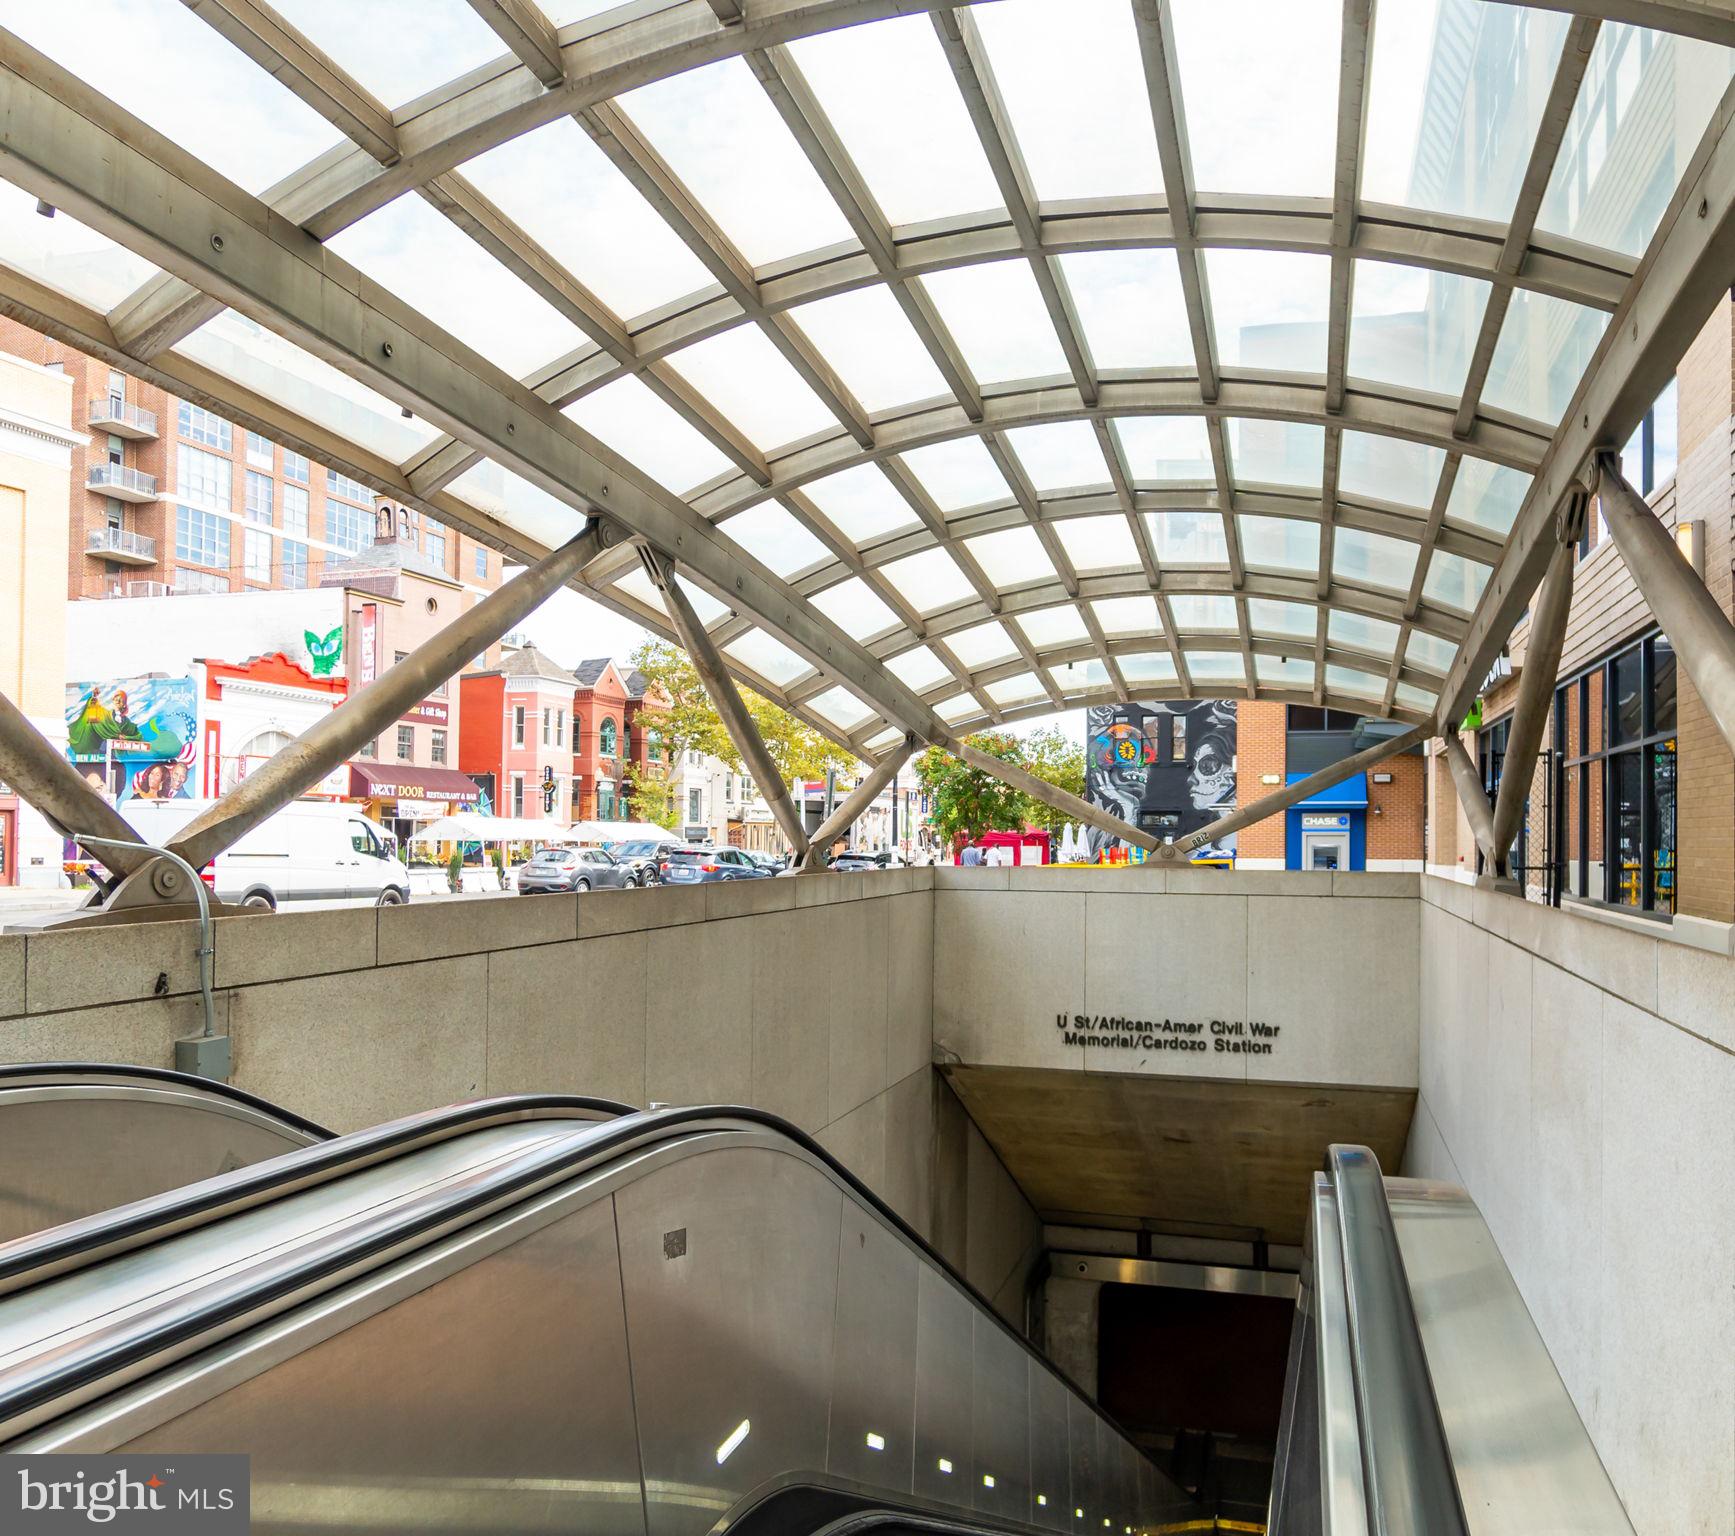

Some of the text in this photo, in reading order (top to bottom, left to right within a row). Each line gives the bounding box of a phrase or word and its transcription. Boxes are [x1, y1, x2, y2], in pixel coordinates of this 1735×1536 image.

[398, 786, 424, 798] DOOR
[1303, 816, 1338, 826] CHASE
[1056, 1014, 1281, 1037] U St/African-Amer Civil War
[1063, 1031, 1273, 1055] Memorial/Cardozo Station
